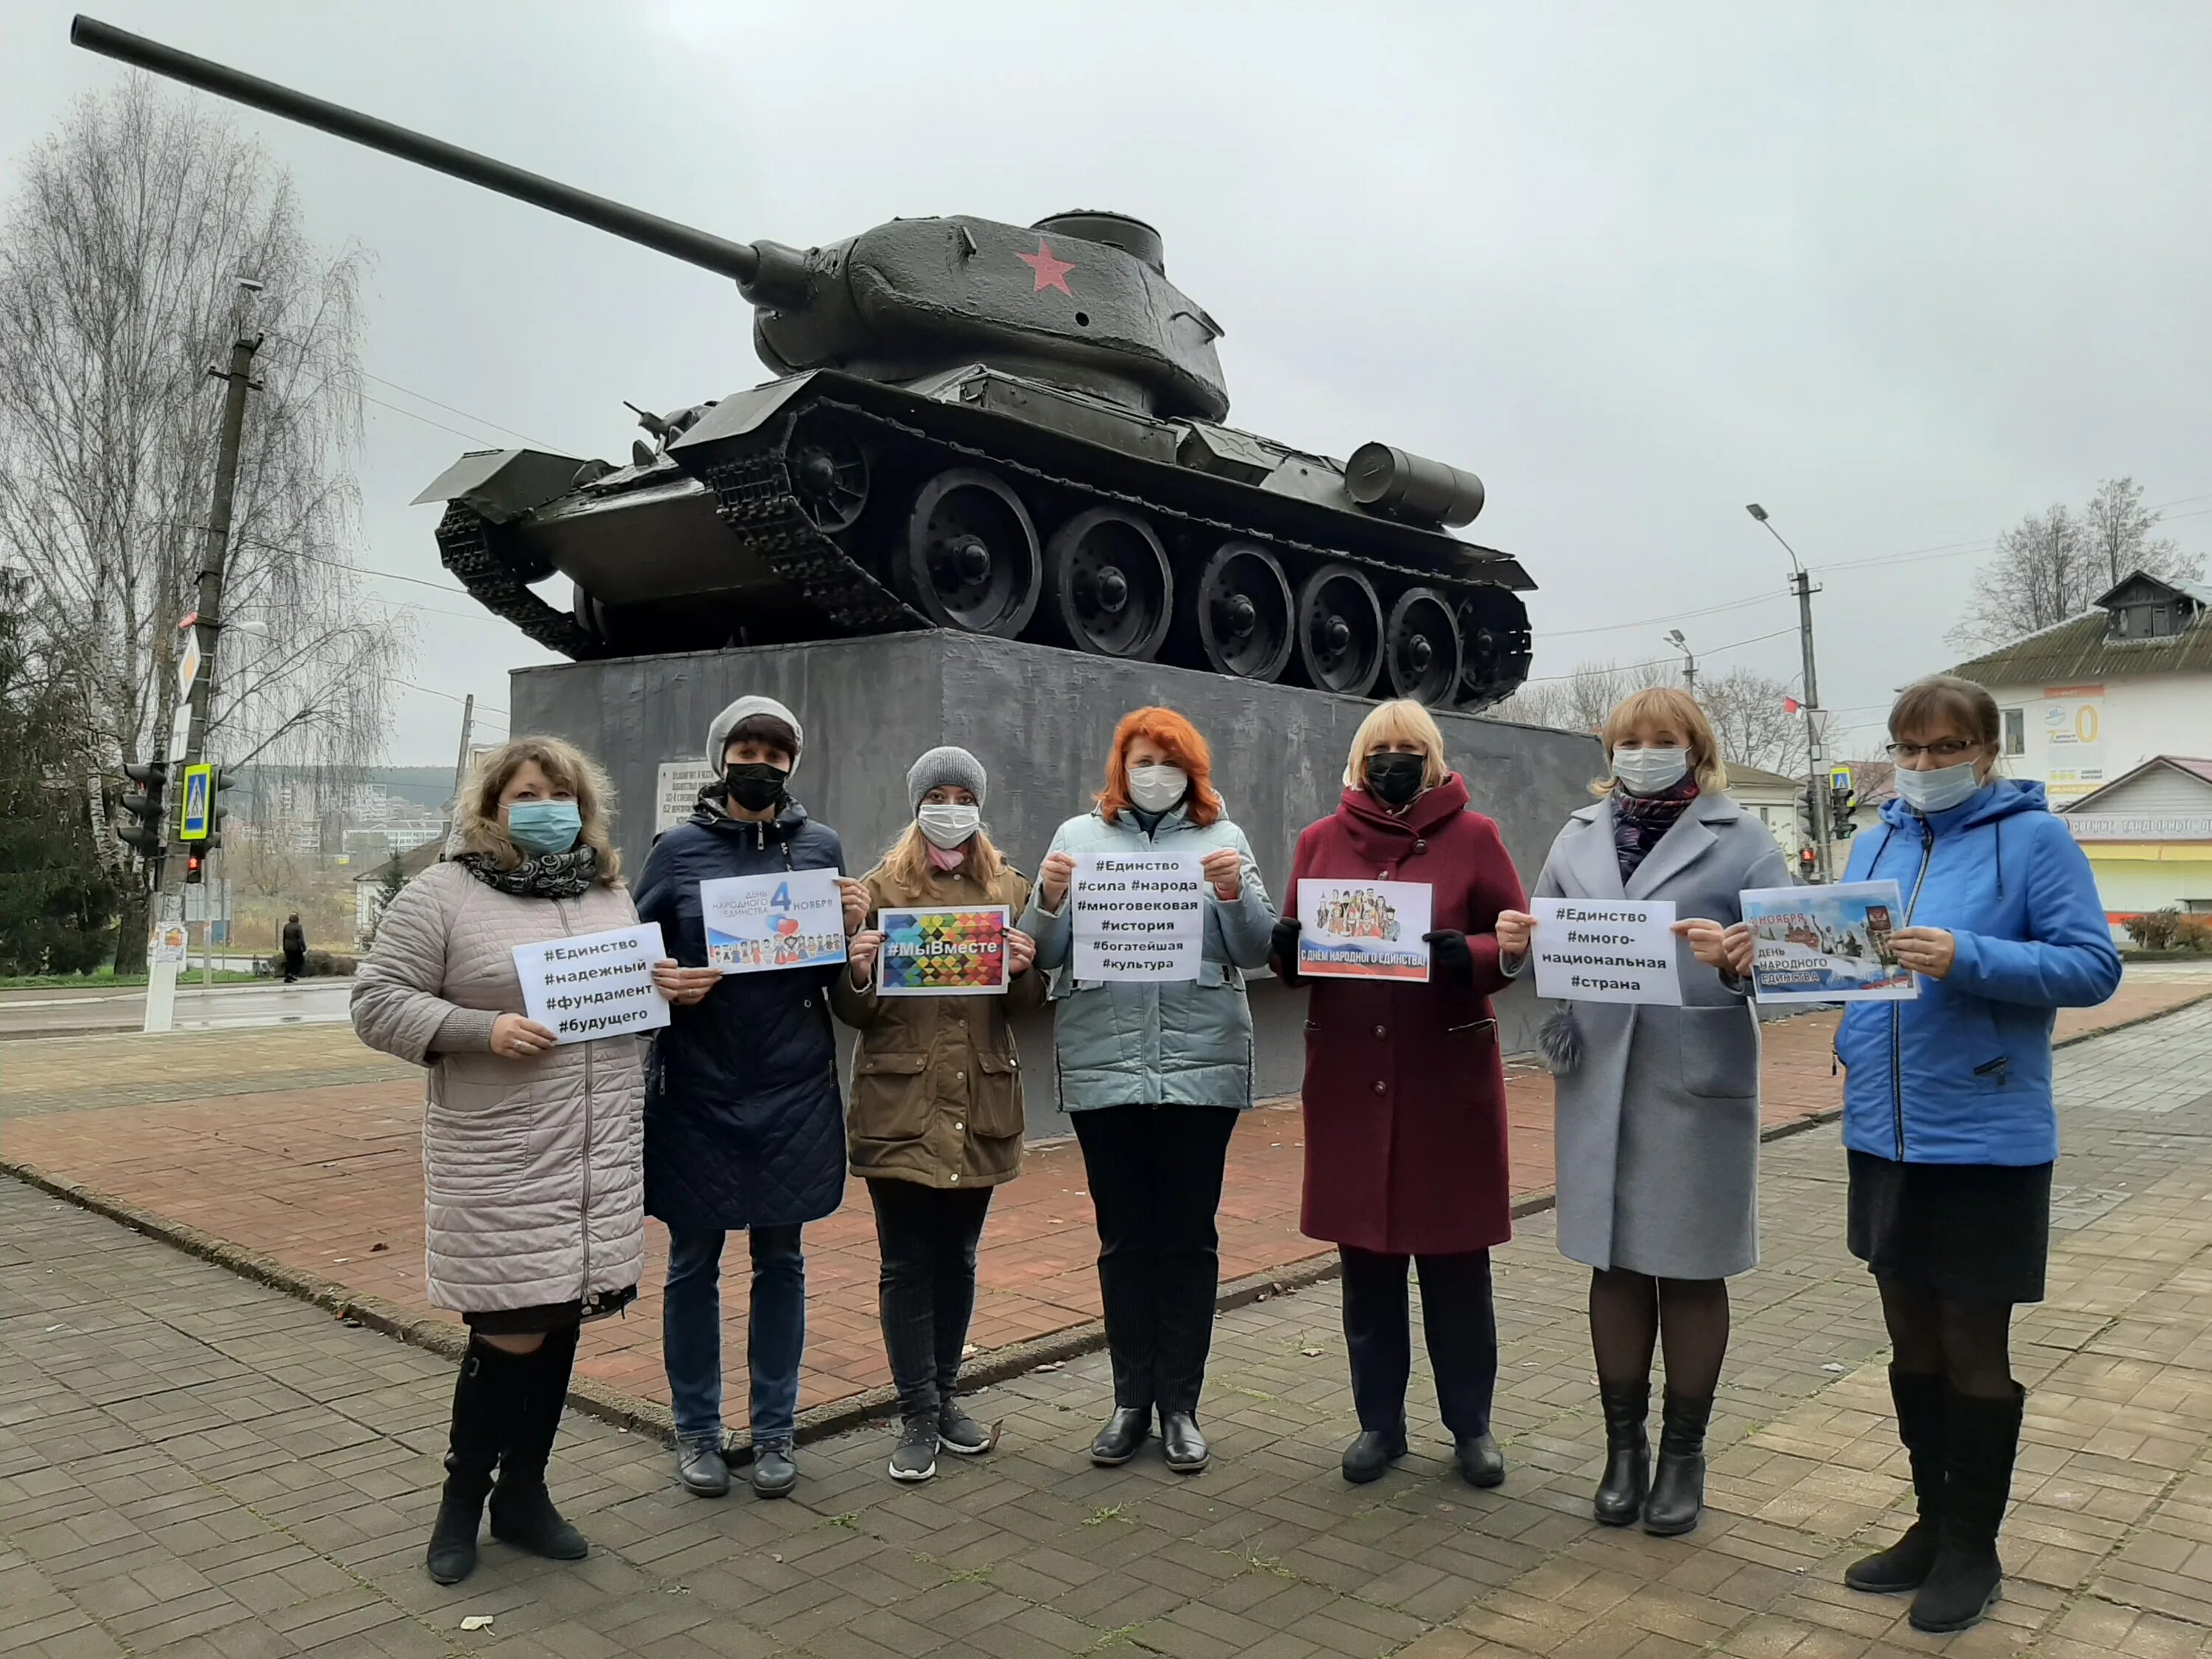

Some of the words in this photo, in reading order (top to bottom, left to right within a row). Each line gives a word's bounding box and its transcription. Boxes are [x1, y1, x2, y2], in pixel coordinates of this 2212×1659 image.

[1096, 860, 1180, 873] #Единство
[1078, 880, 1126, 891] #сила
[1131, 880, 1197, 893] #народа
[745, 891, 768, 899] ДЕНЬ
[771, 881, 792, 911] 4
[793, 899, 832, 911] НОЯБРЯ
[712, 899, 768, 910] НАРОДНОГО
[1077, 900, 1198, 911] #многовековая
[723, 908, 768, 917] ЕДИНСТВА
[1556, 908, 1647, 922] #Единство
[1759, 913, 1806, 925] НОЯБРЯ
[1101, 920, 1175, 933] #история
[1568, 931, 1635, 945] #много-
[544, 939, 638, 961] #Единство
[888, 941, 998, 956] #МыВместе
[1093, 941, 1183, 951] #богатейшая
[1758, 947, 1785, 958] ДЕНЬ
[1301, 949, 1307, 960] С
[1329, 950, 1377, 964] НАРОДНОГО
[1379, 952, 1426, 966] ЕДИНСТВА!
[1542, 953, 1666, 969] национальная
[1759, 958, 1827, 970] НАРОДНОГО
[1102, 959, 1174, 971] #культура
[544, 959, 647, 985] #надежный
[1761, 972, 1820, 985] ЕДИНСТВА
[1571, 975, 1641, 991] #страна
[546, 984, 653, 1010] #фундамент
[559, 1010, 648, 1033] #будущего
